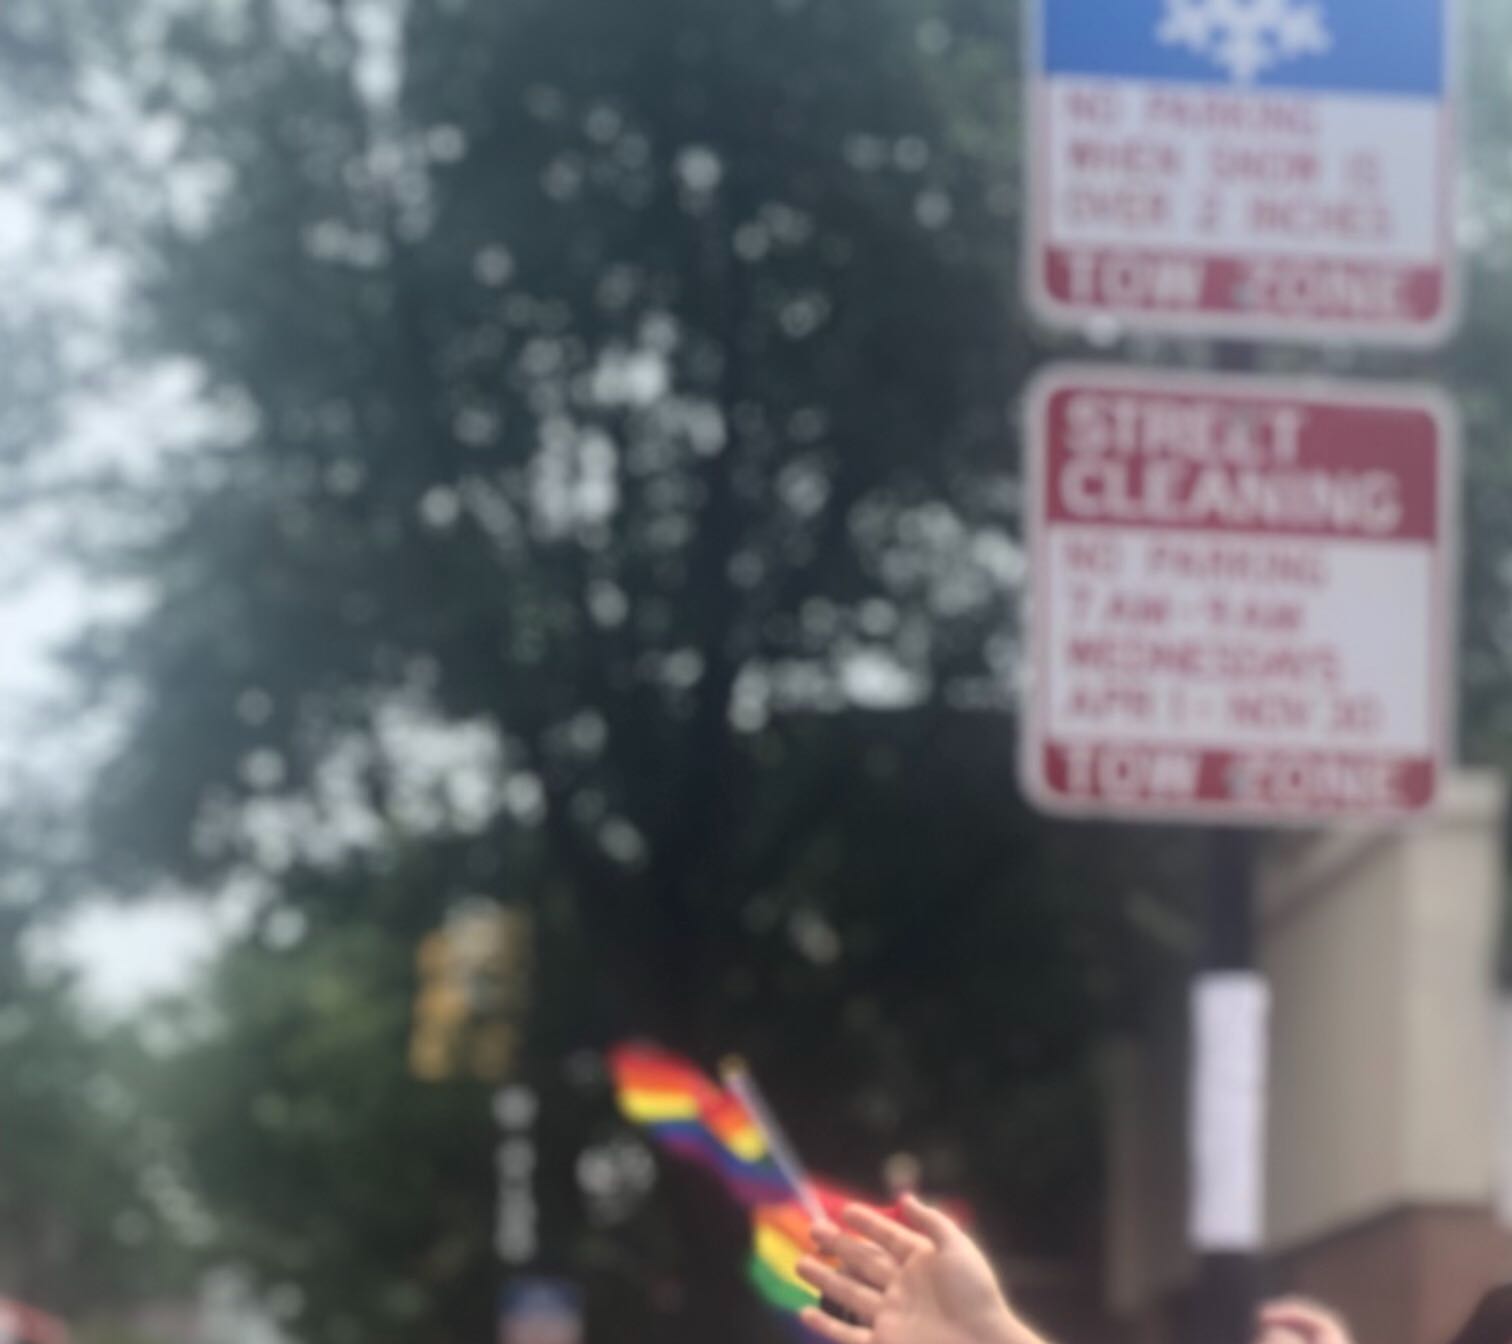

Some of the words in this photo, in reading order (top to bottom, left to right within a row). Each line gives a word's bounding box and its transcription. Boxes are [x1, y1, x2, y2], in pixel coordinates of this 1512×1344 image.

[1145, 95, 1322, 134] PARKING
[1069, 141, 1180, 175] WHEN
[1209, 147, 1320, 183] SNOW
[1067, 190, 1170, 226] OVER
[1248, 199, 1393, 239] INCHES
[1068, 252, 1203, 306] TOW
[1236, 261, 1402, 321] ZONE
[1063, 395, 1306, 466] STREET
[1060, 459, 1403, 534] CLEANING
[1146, 544, 1328, 588] PARKING
[1067, 639, 1340, 687] WEDNESDAYS
[1064, 745, 1199, 800] TOW
[1231, 754, 1397, 809] ZONE
